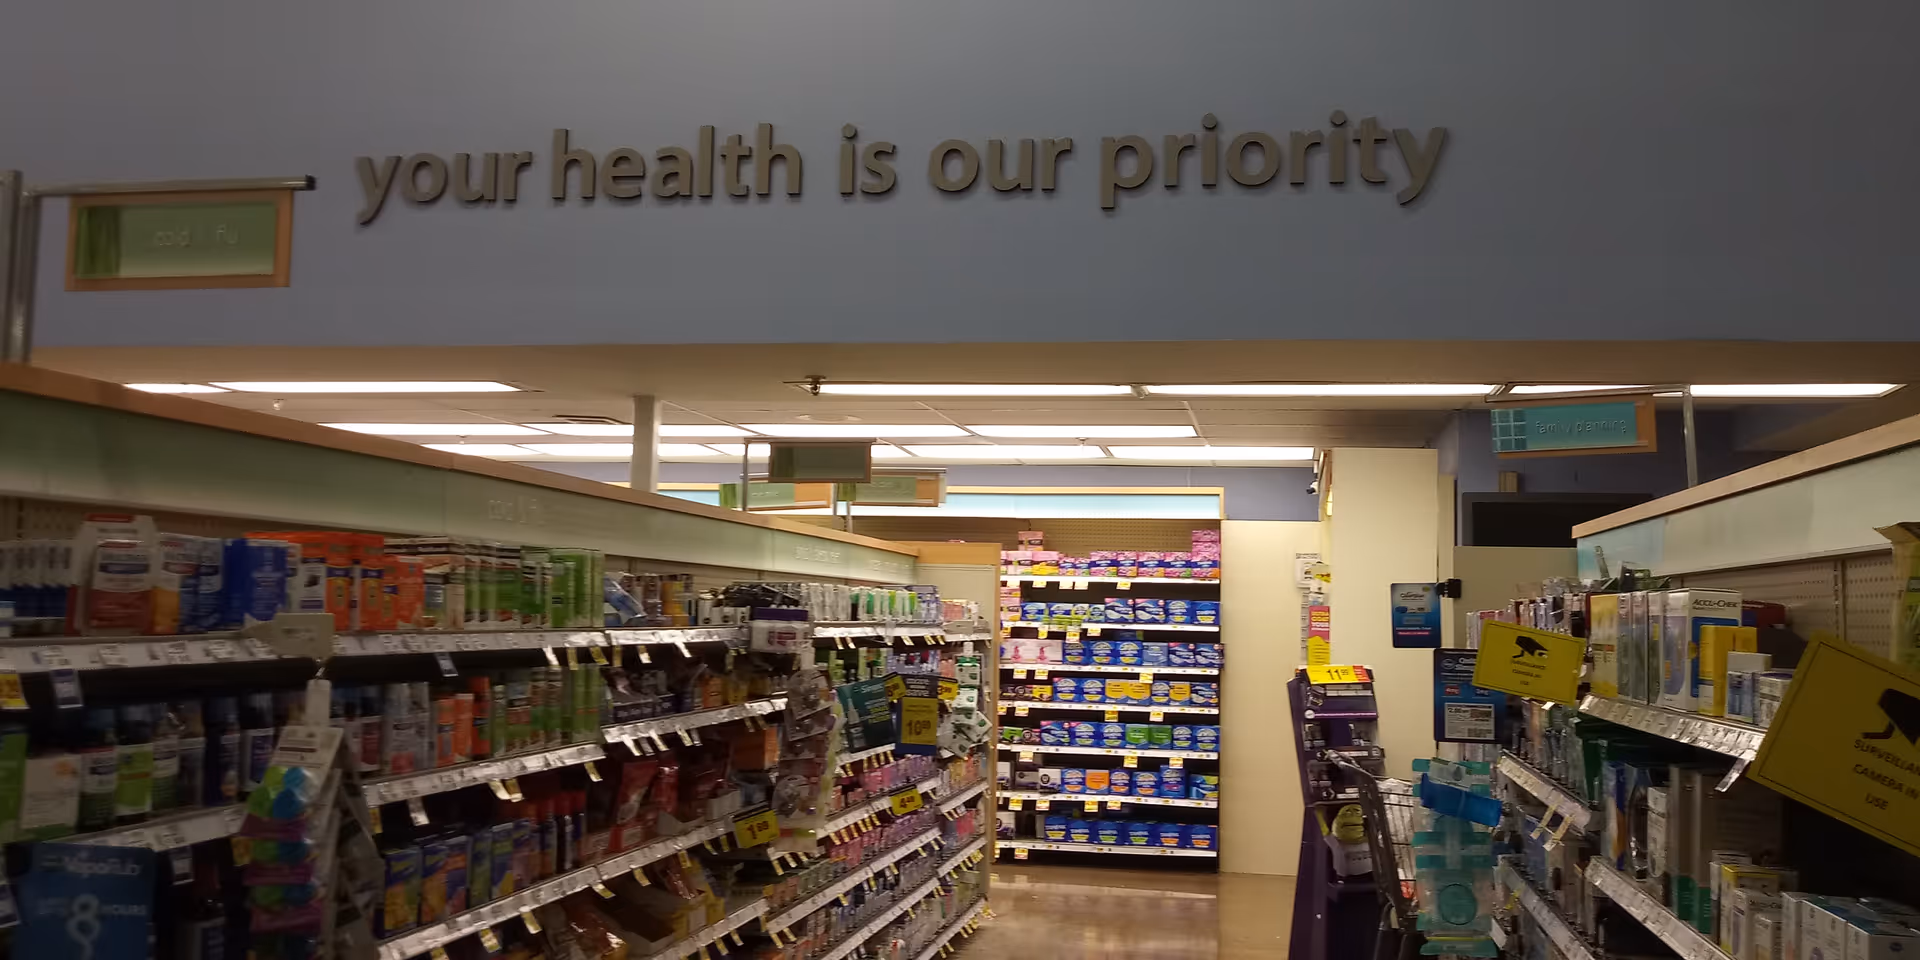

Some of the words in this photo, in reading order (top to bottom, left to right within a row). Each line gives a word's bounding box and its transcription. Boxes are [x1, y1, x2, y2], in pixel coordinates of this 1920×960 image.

[355, 149, 533, 226] your
[551, 122, 803, 200] health
[838, 122, 898, 196] is
[928, 136, 1074, 194] our
[1101, 109, 1448, 212] priority
[1536, 418, 1572, 434] family
[1576, 417, 1627, 435] planning
[1853, 763, 1904, 792] CAMERA
[1865, 792, 1889, 811] USE
